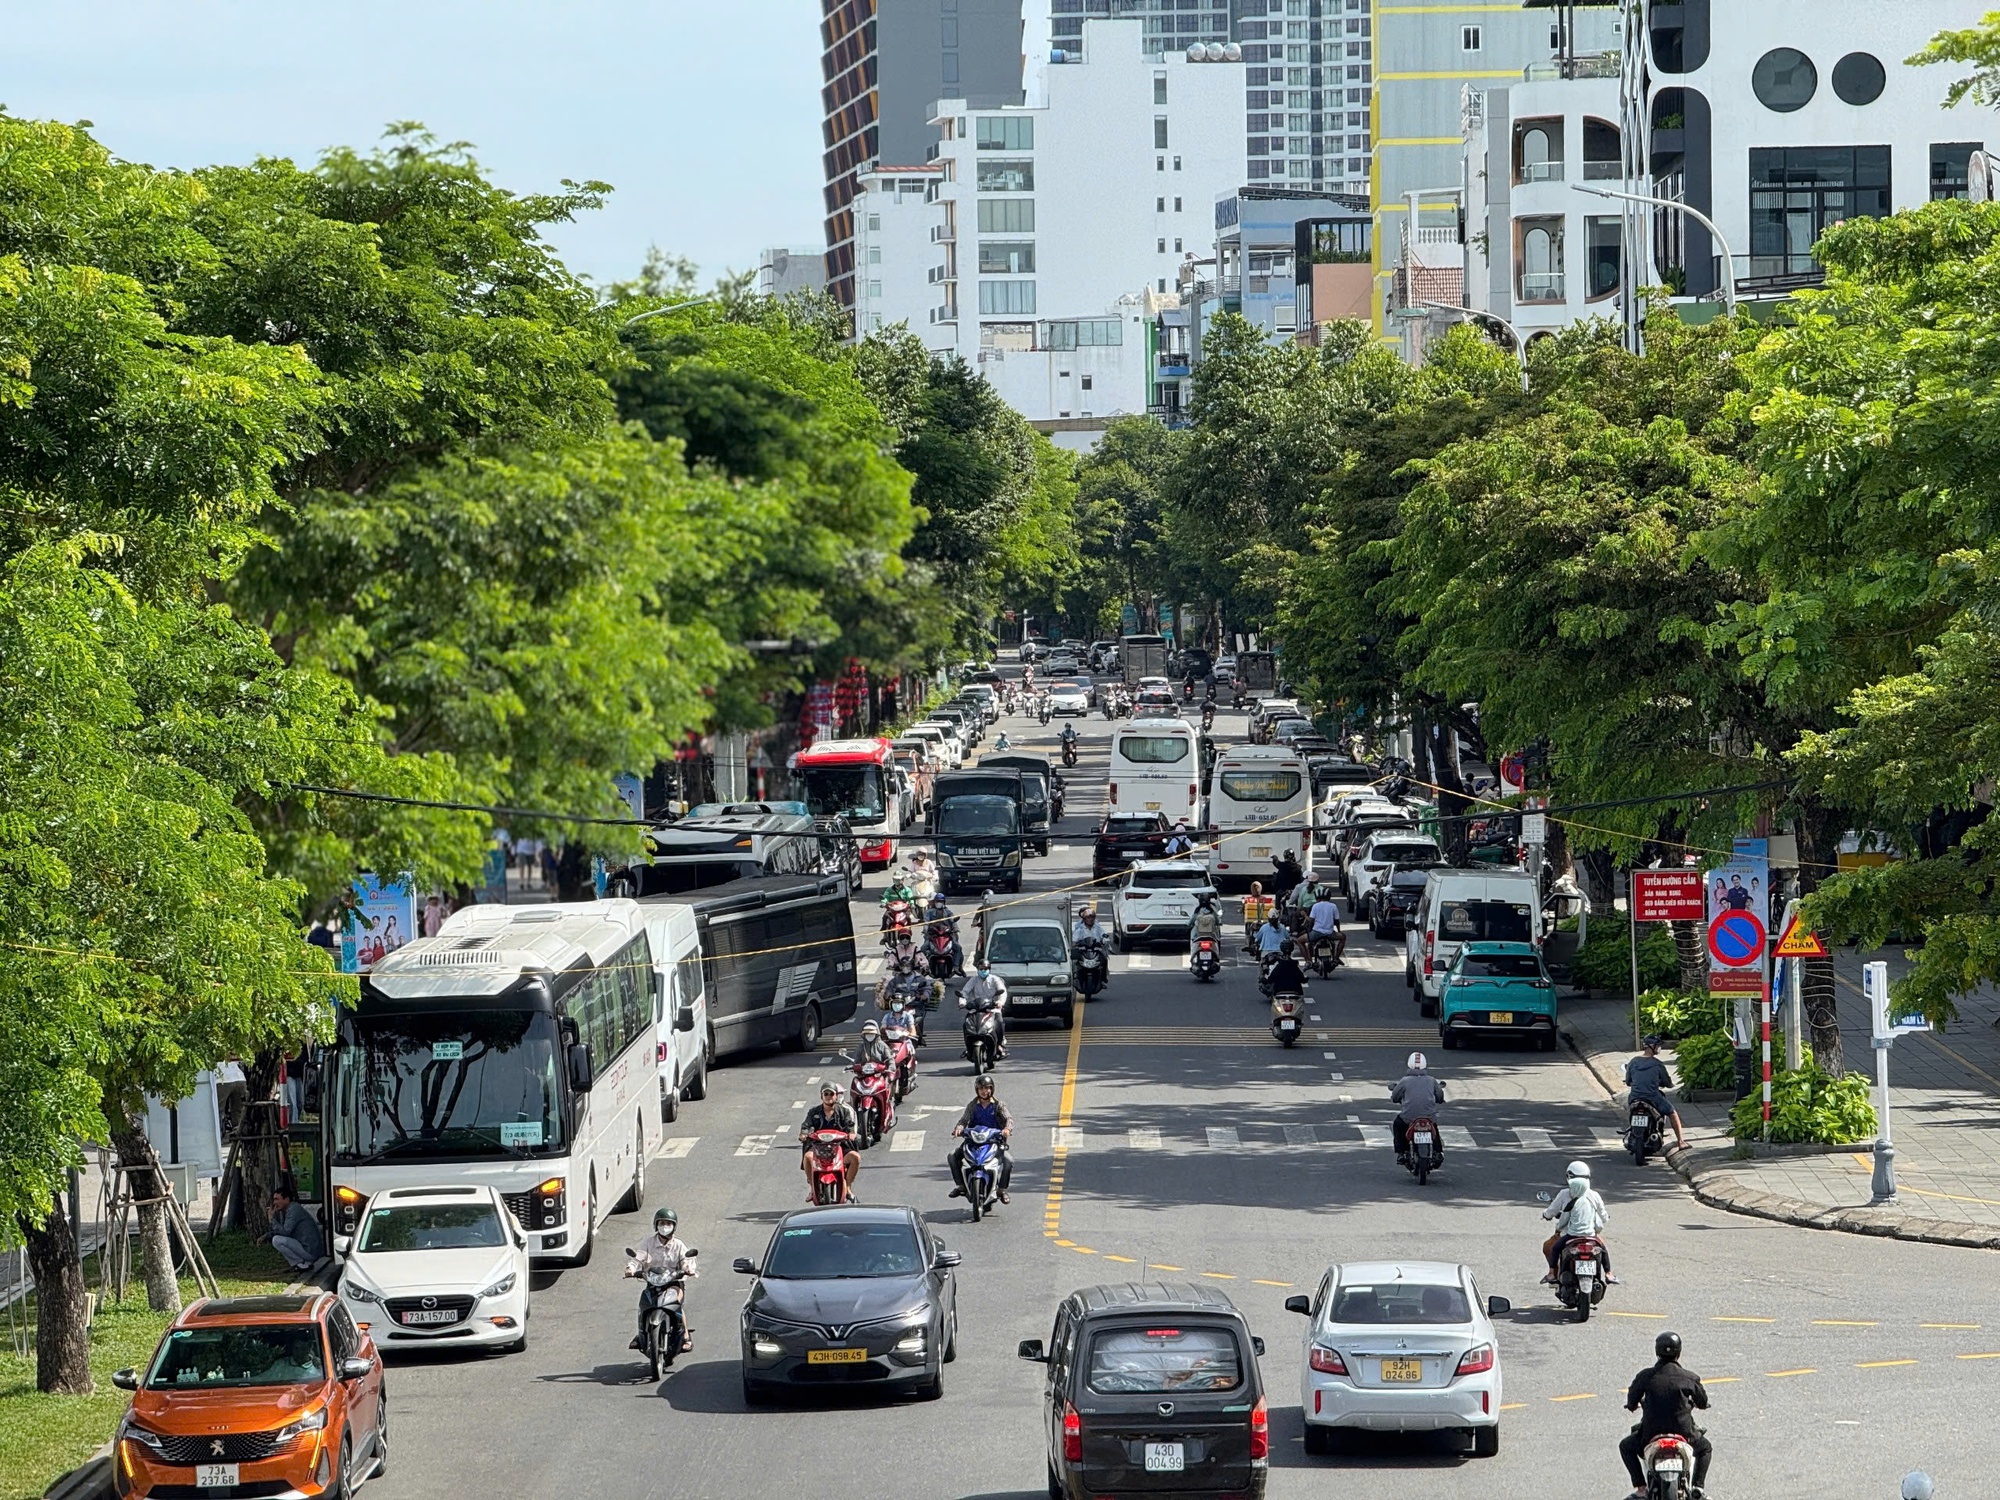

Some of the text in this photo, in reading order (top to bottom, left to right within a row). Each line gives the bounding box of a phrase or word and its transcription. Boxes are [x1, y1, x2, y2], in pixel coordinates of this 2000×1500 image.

[965, 847, 978, 855] TÔNG
[978, 846, 989, 856] VIỆT
[408, 1311, 456, 1322] 73A-157.00
[1392, 1361, 1410, 1370] 92H
[1385, 1370, 1418, 1380] 024.86
[1155, 1444, 1174, 1456] 43D
[1147, 1456, 1182, 1469] 004.99
[208, 1466, 227, 1476] 73A
[201, 1475, 235, 1486] 237.68
